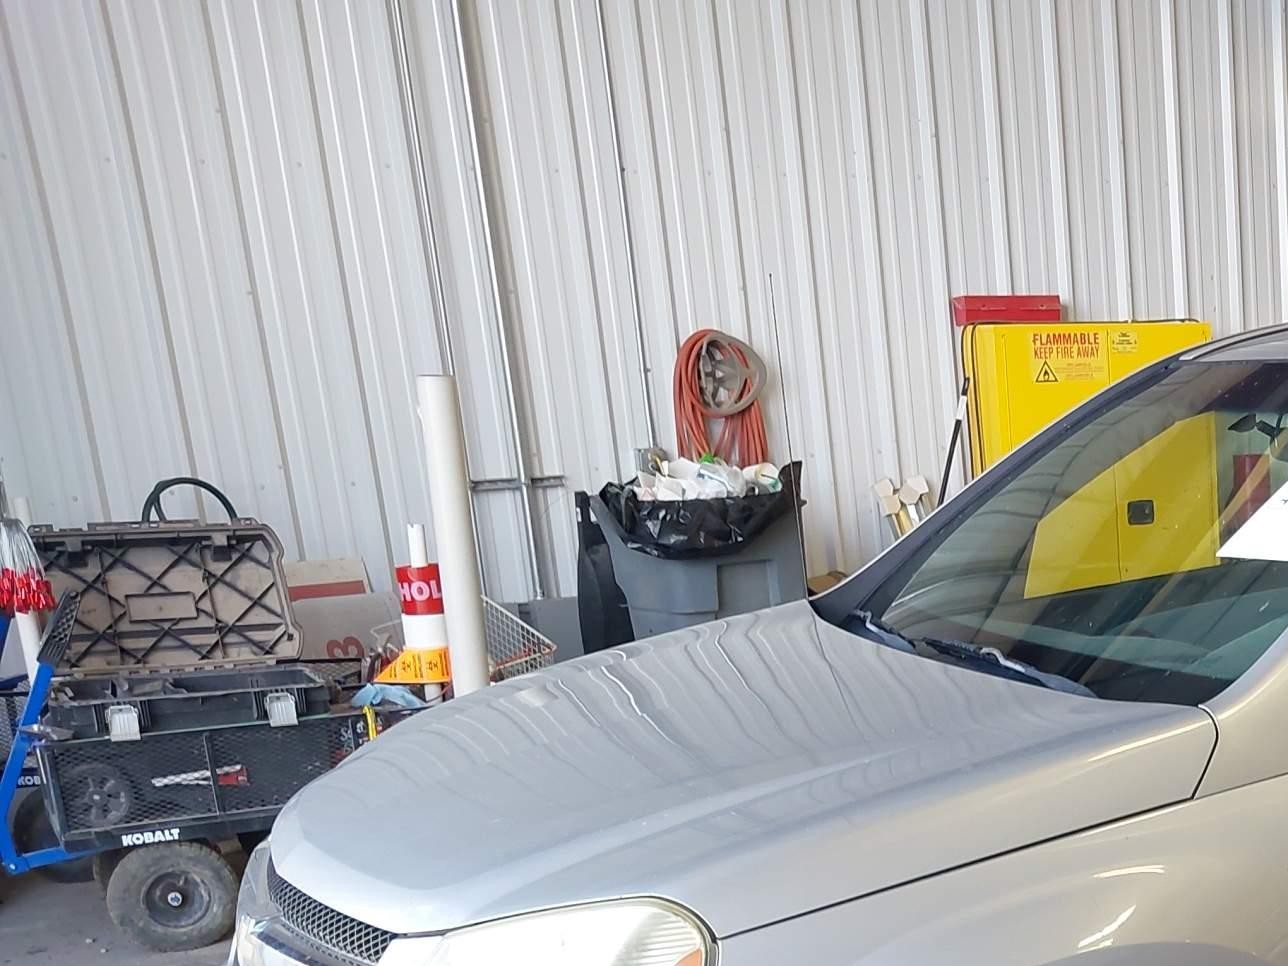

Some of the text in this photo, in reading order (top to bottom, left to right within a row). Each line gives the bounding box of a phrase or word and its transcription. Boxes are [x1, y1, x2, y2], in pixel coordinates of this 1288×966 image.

[1032, 333, 1099, 346] FLAMMABLE
[1033, 346, 1099, 360] KEEP FIRE AWAY
[121, 828, 180, 847] KOBALT
